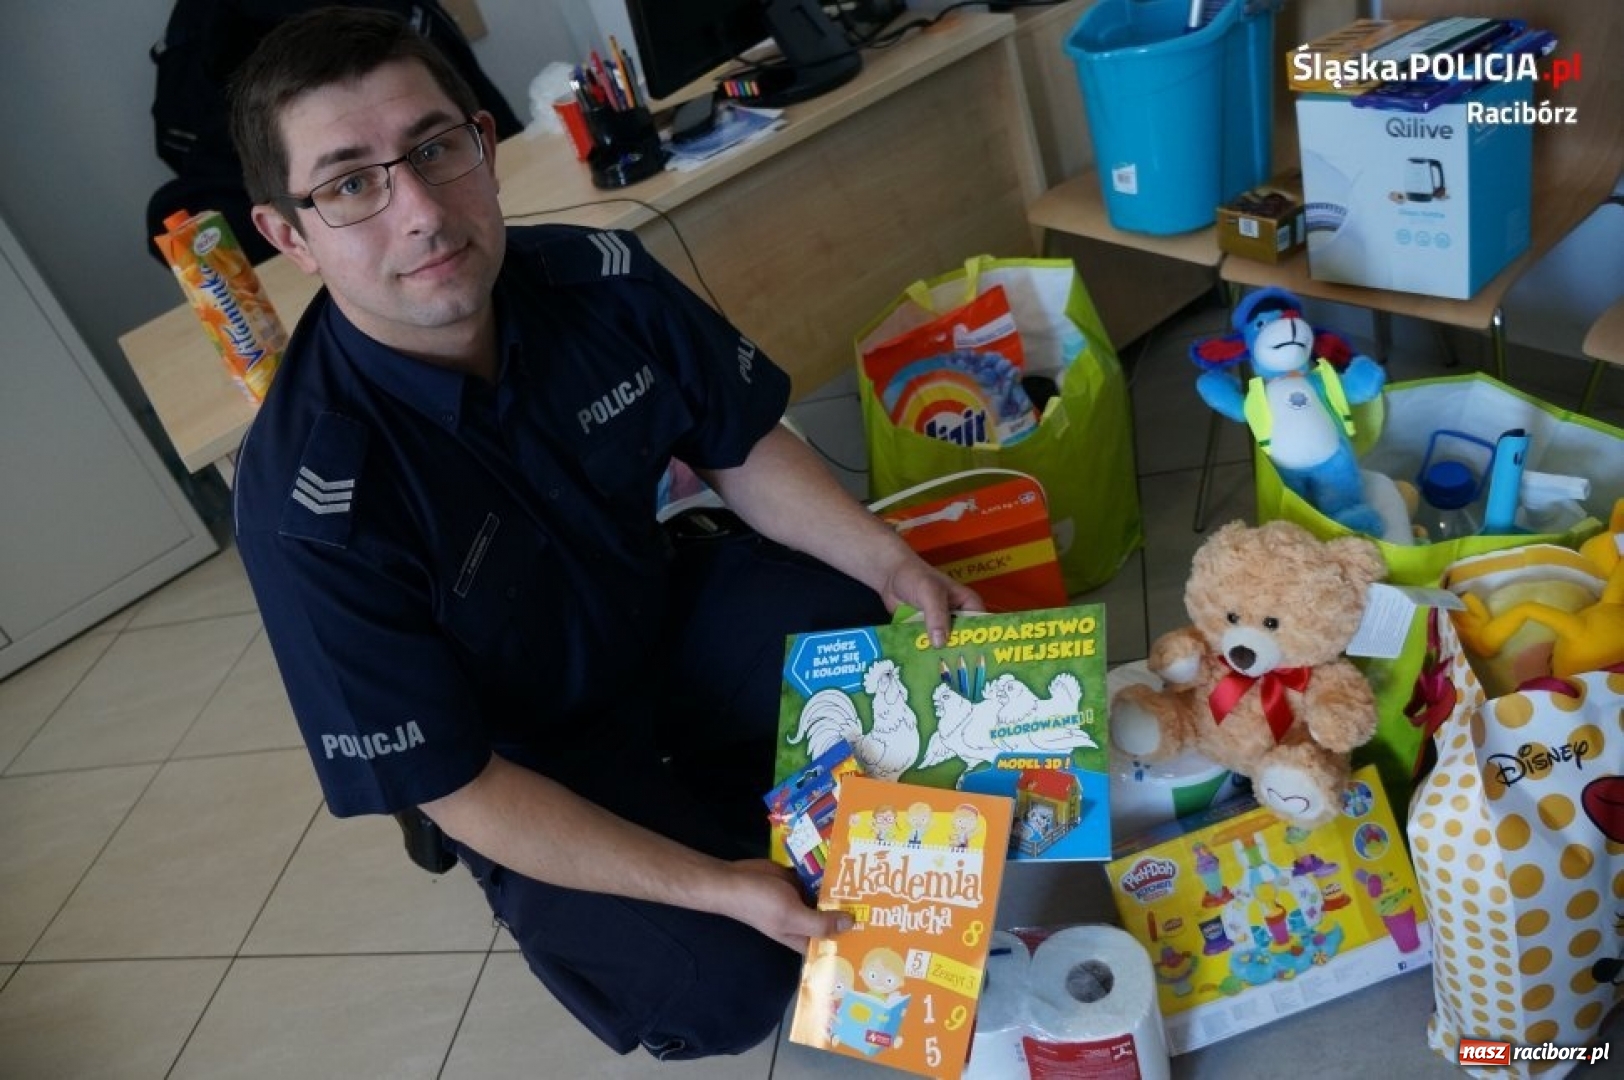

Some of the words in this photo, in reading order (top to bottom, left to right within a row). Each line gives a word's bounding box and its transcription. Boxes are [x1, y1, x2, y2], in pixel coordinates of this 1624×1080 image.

[1385, 116, 1454, 139] Qilive
[577, 364, 656, 434] POLICJA
[816, 638, 857, 655] TWÓRZ
[915, 616, 1096, 650] GSPODARSTWO
[813, 654, 840, 667] BAW
[993, 639, 1096, 665] WIEJSKIE
[812, 661, 867, 679] KOLORUJ!
[321, 720, 426, 760] POLICJA
[997, 757, 1041, 770] MODEL
[1044, 757, 1062, 770] 3D
[831, 851, 983, 902] Akademia
[872, 903, 952, 934] malucha
[962, 920, 984, 947] 8
[923, 994, 935, 1024] 1
[944, 1004, 968, 1031] 9
[925, 1036, 942, 1067] 5
